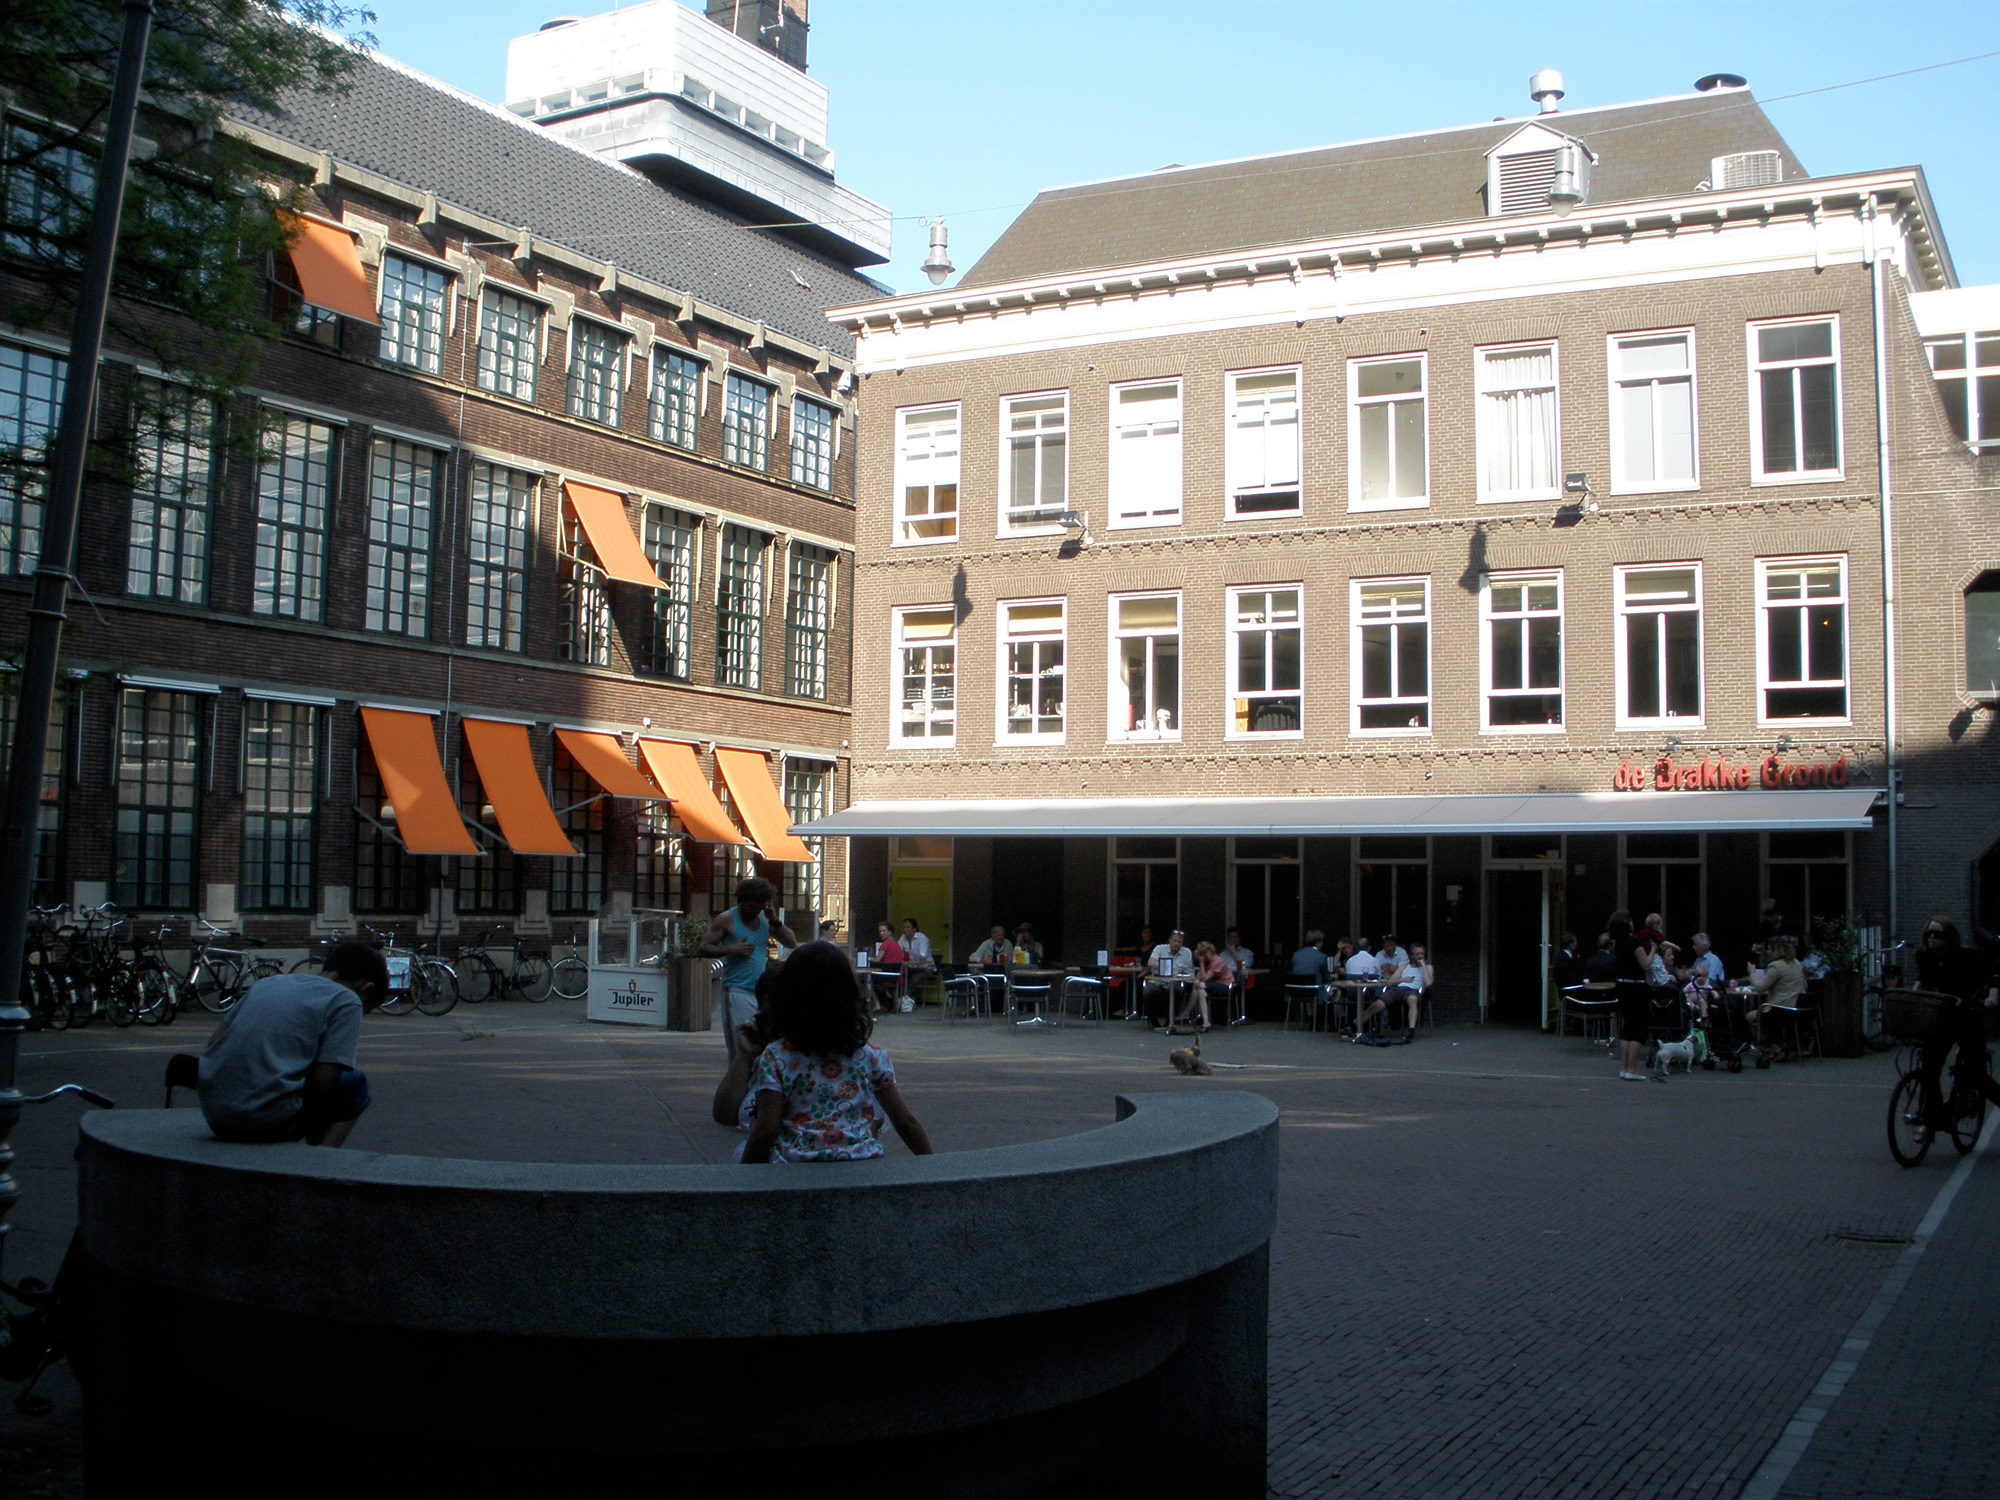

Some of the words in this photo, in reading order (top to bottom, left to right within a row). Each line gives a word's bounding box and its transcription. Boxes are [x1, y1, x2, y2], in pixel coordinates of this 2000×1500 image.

[1614, 758, 1644, 788] de
[1655, 758, 1750, 788] Brakke
[1763, 755, 1847, 788] Grond
[613, 991, 654, 1007] Jupiler
